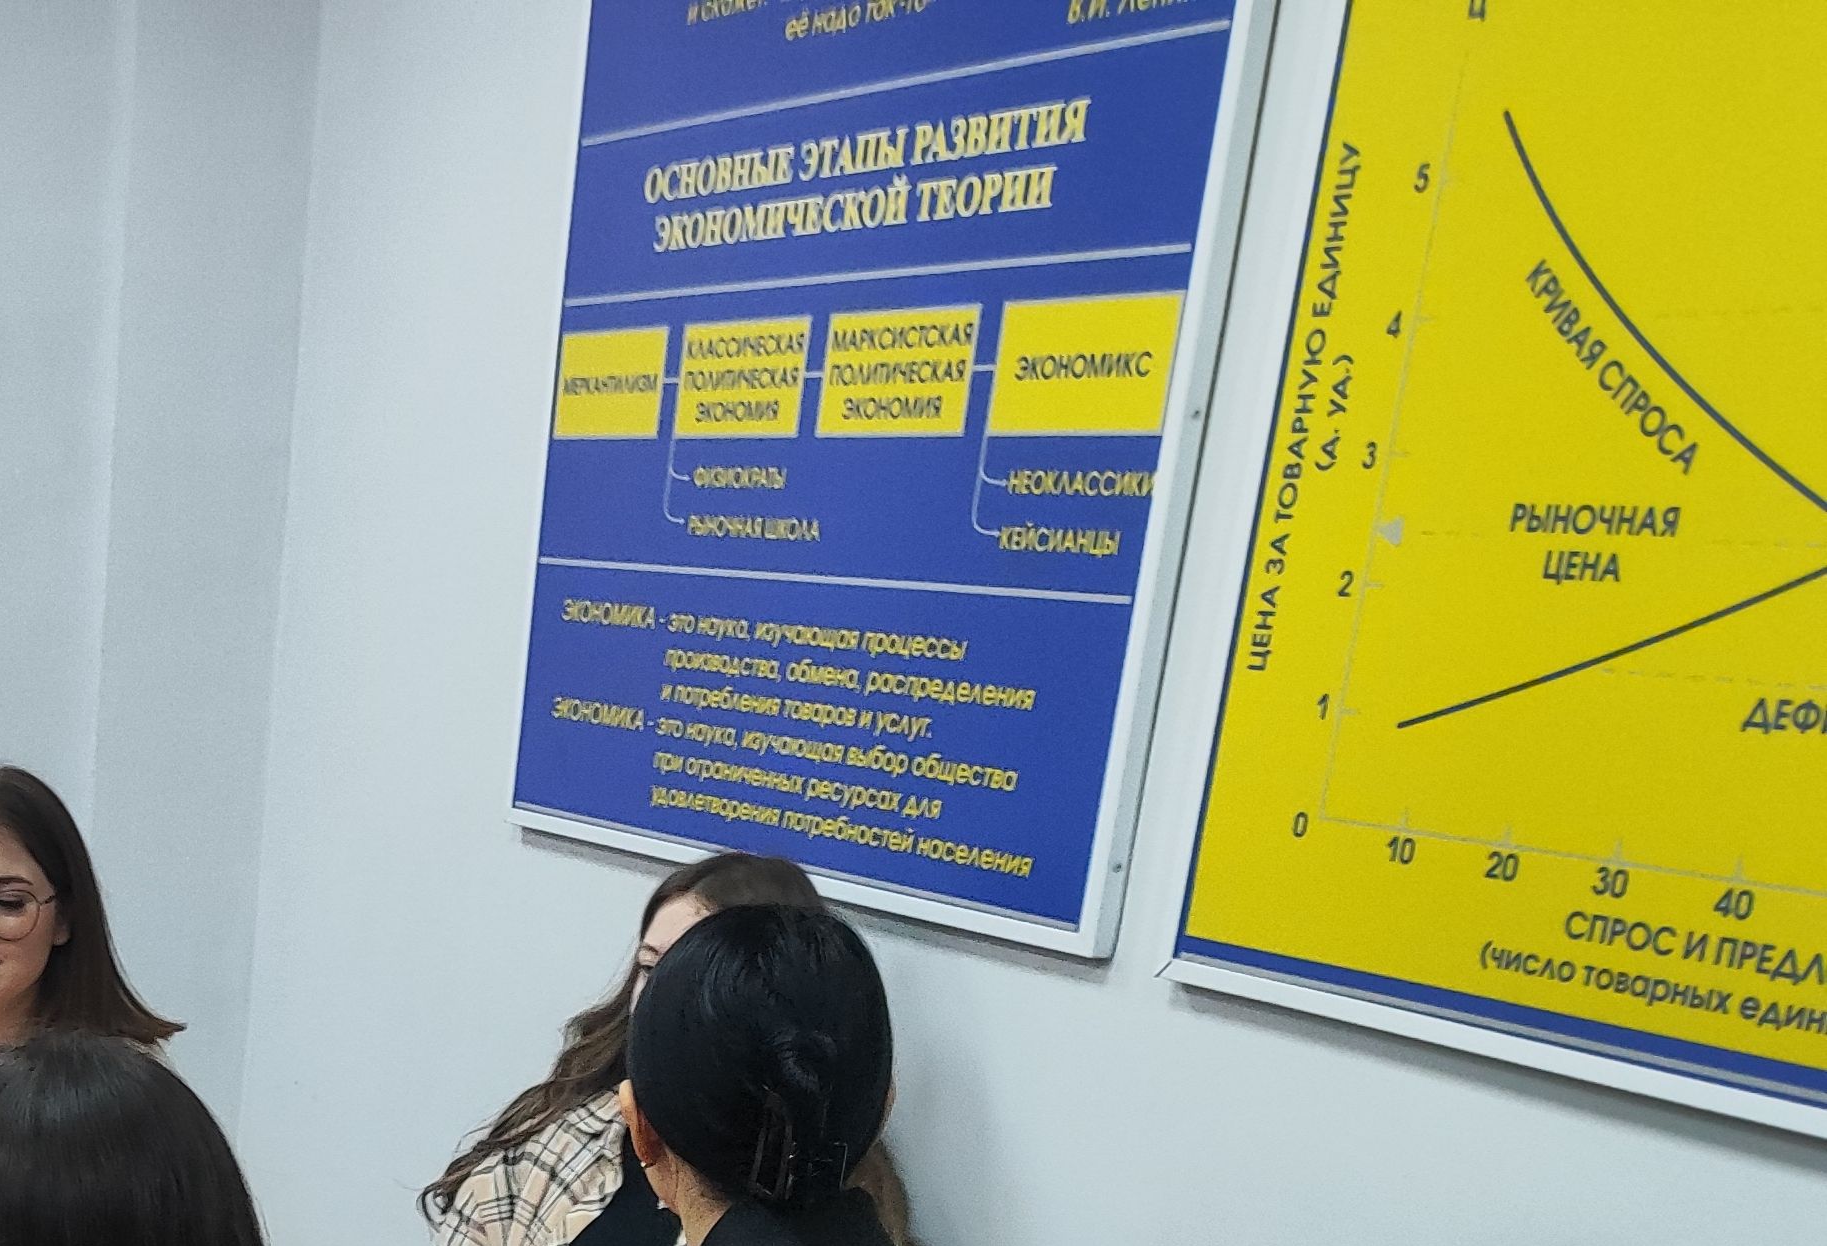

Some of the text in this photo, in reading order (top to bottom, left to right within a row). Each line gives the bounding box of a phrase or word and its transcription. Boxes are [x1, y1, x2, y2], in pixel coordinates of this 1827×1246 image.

[785, 9, 809, 42] её
[811, 4, 862, 37] надо
[644, 96, 1092, 203] ОСНОВНЫЕ ЭТАПЫ РАЗВИТИЯ
[1414, 163, 1430, 194] 5
[652, 164, 1058, 253] ЭКОНОМИЧЕСКОЙ ТЕОРИИ
[831, 322, 974, 352] МАРКСИСТСКАЯ
[1386, 310, 1403, 339] 4
[828, 359, 968, 387] ПОЛИТИЧЕСКАЯ
[1014, 351, 1154, 381] ЭКОНОМИКС
[1525, 258, 1699, 476] КРИВАЯ СПРОСА
[694, 400, 779, 423] ЭКОНОМИЯ
[841, 395, 942, 421] ЭКОНОМИЯ
[1247, 141, 1361, 671] ЦЕНА ЗА ТОВАРНУЮ ЕДИНИЦУ
[1362, 441, 1378, 470] 3
[1006, 469, 1156, 497] НЕОКЛАССИКИ
[1509, 502, 1681, 538] РЫНОЧНАЯ
[998, 520, 1121, 557] КЕЙСИАНЦЫ
[1337, 570, 1355, 598] 2
[1542, 550, 1621, 586] ЦЕНА
[561, 598, 655, 630] ЭКОНОМИКА
[667, 613, 695, 634] это
[862, 630, 969, 661] процессы
[786, 658, 861, 694] обмена,
[863, 670, 1038, 711] распределения
[675, 684, 781, 717] потребления
[783, 698, 857, 729] товаров
[858, 708, 873, 730] и
[873, 710, 933, 742] услуг.
[1316, 693, 1330, 721] 1
[551, 696, 645, 732] ЭКОНОМИКА
[655, 717, 684, 738] это
[845, 744, 909, 779] выбор
[911, 752, 1019, 792] общества
[685, 757, 806, 794] ограниченных
[805, 778, 904, 812] ресурсах
[901, 795, 943, 820] для
[781, 810, 916, 856] потребностей
[916, 836, 1036, 878] населения
[1386, 836, 1416, 866] 10
[1485, 850, 1519, 883] 20
[1592, 865, 1629, 899] 30
[1713, 889, 1755, 922] 40
[1564, 911, 1678, 957] СПРОС
[1682, 930, 1709, 962] И
[1480, 940, 1575, 983] (число
[1582, 964, 1734, 1014] товарных
